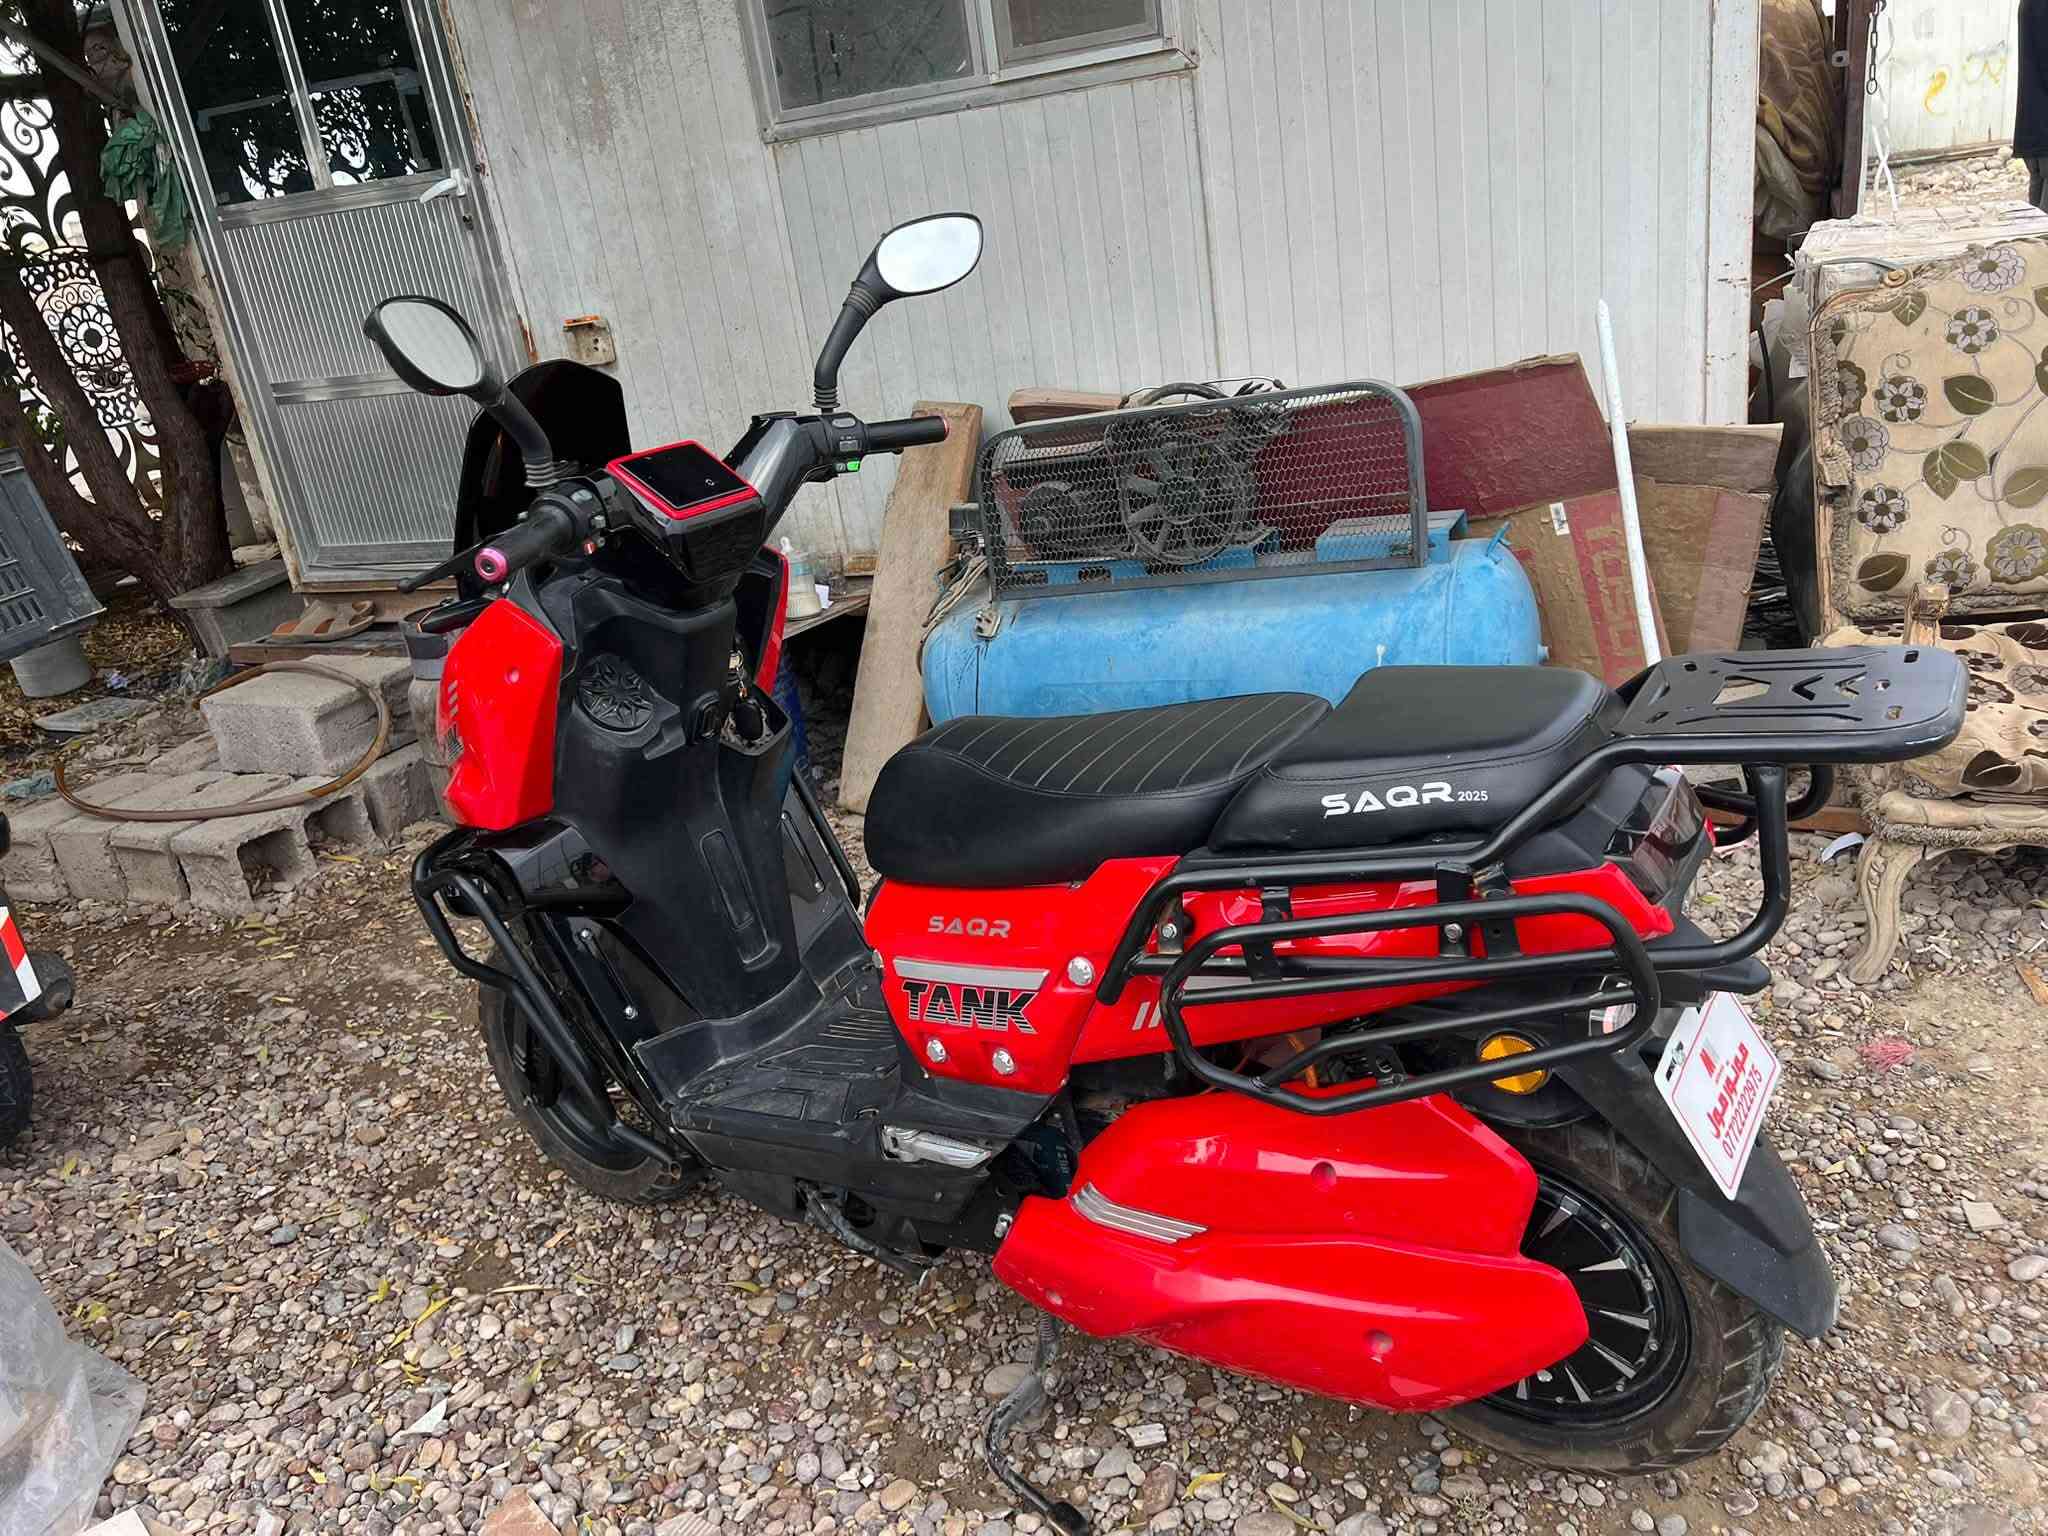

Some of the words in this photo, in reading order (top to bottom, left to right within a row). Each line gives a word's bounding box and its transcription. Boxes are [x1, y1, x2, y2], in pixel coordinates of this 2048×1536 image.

[1321, 781, 1455, 819] SAQR
[1457, 790, 1488, 802] 2025
[928, 915, 1011, 938] SAQR
[902, 979, 1039, 1035] TANK
